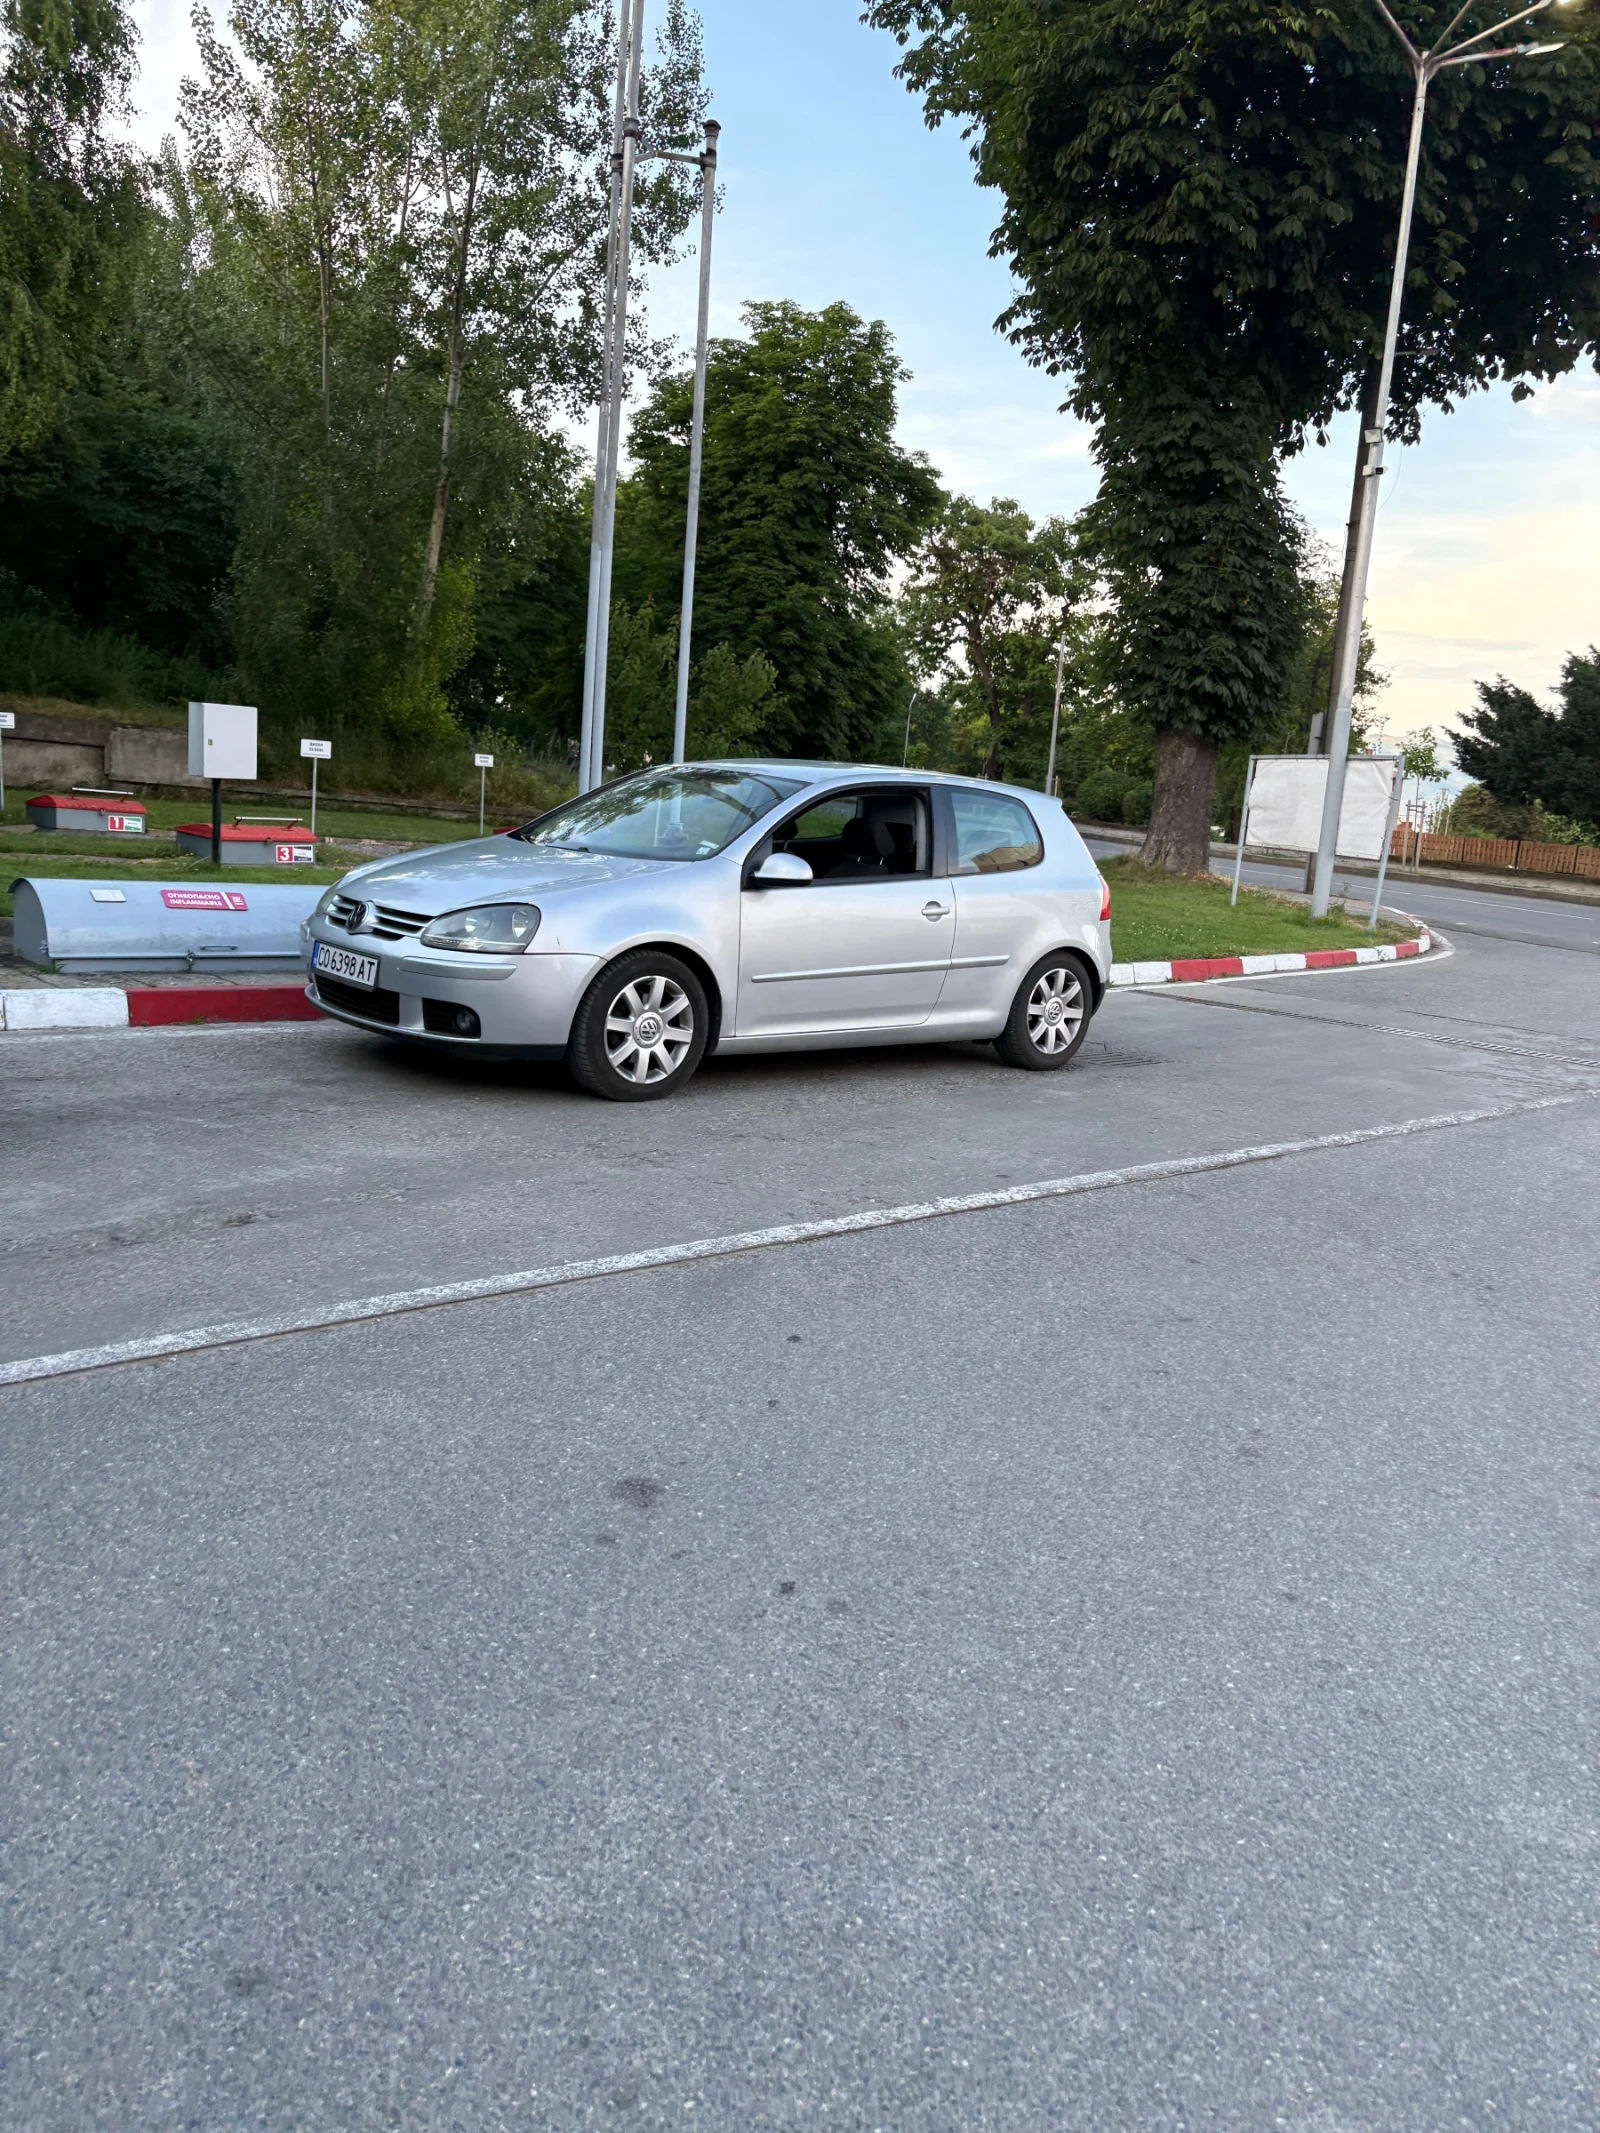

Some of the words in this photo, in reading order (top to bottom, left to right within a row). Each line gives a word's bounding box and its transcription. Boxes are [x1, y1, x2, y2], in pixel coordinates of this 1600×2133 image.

[113, 816, 119, 829] 1
[280, 847, 290, 861] 3
[167, 892, 220, 900] ОГНЕОПАСНО
[169, 899, 223, 907] INFLAMMABLE
